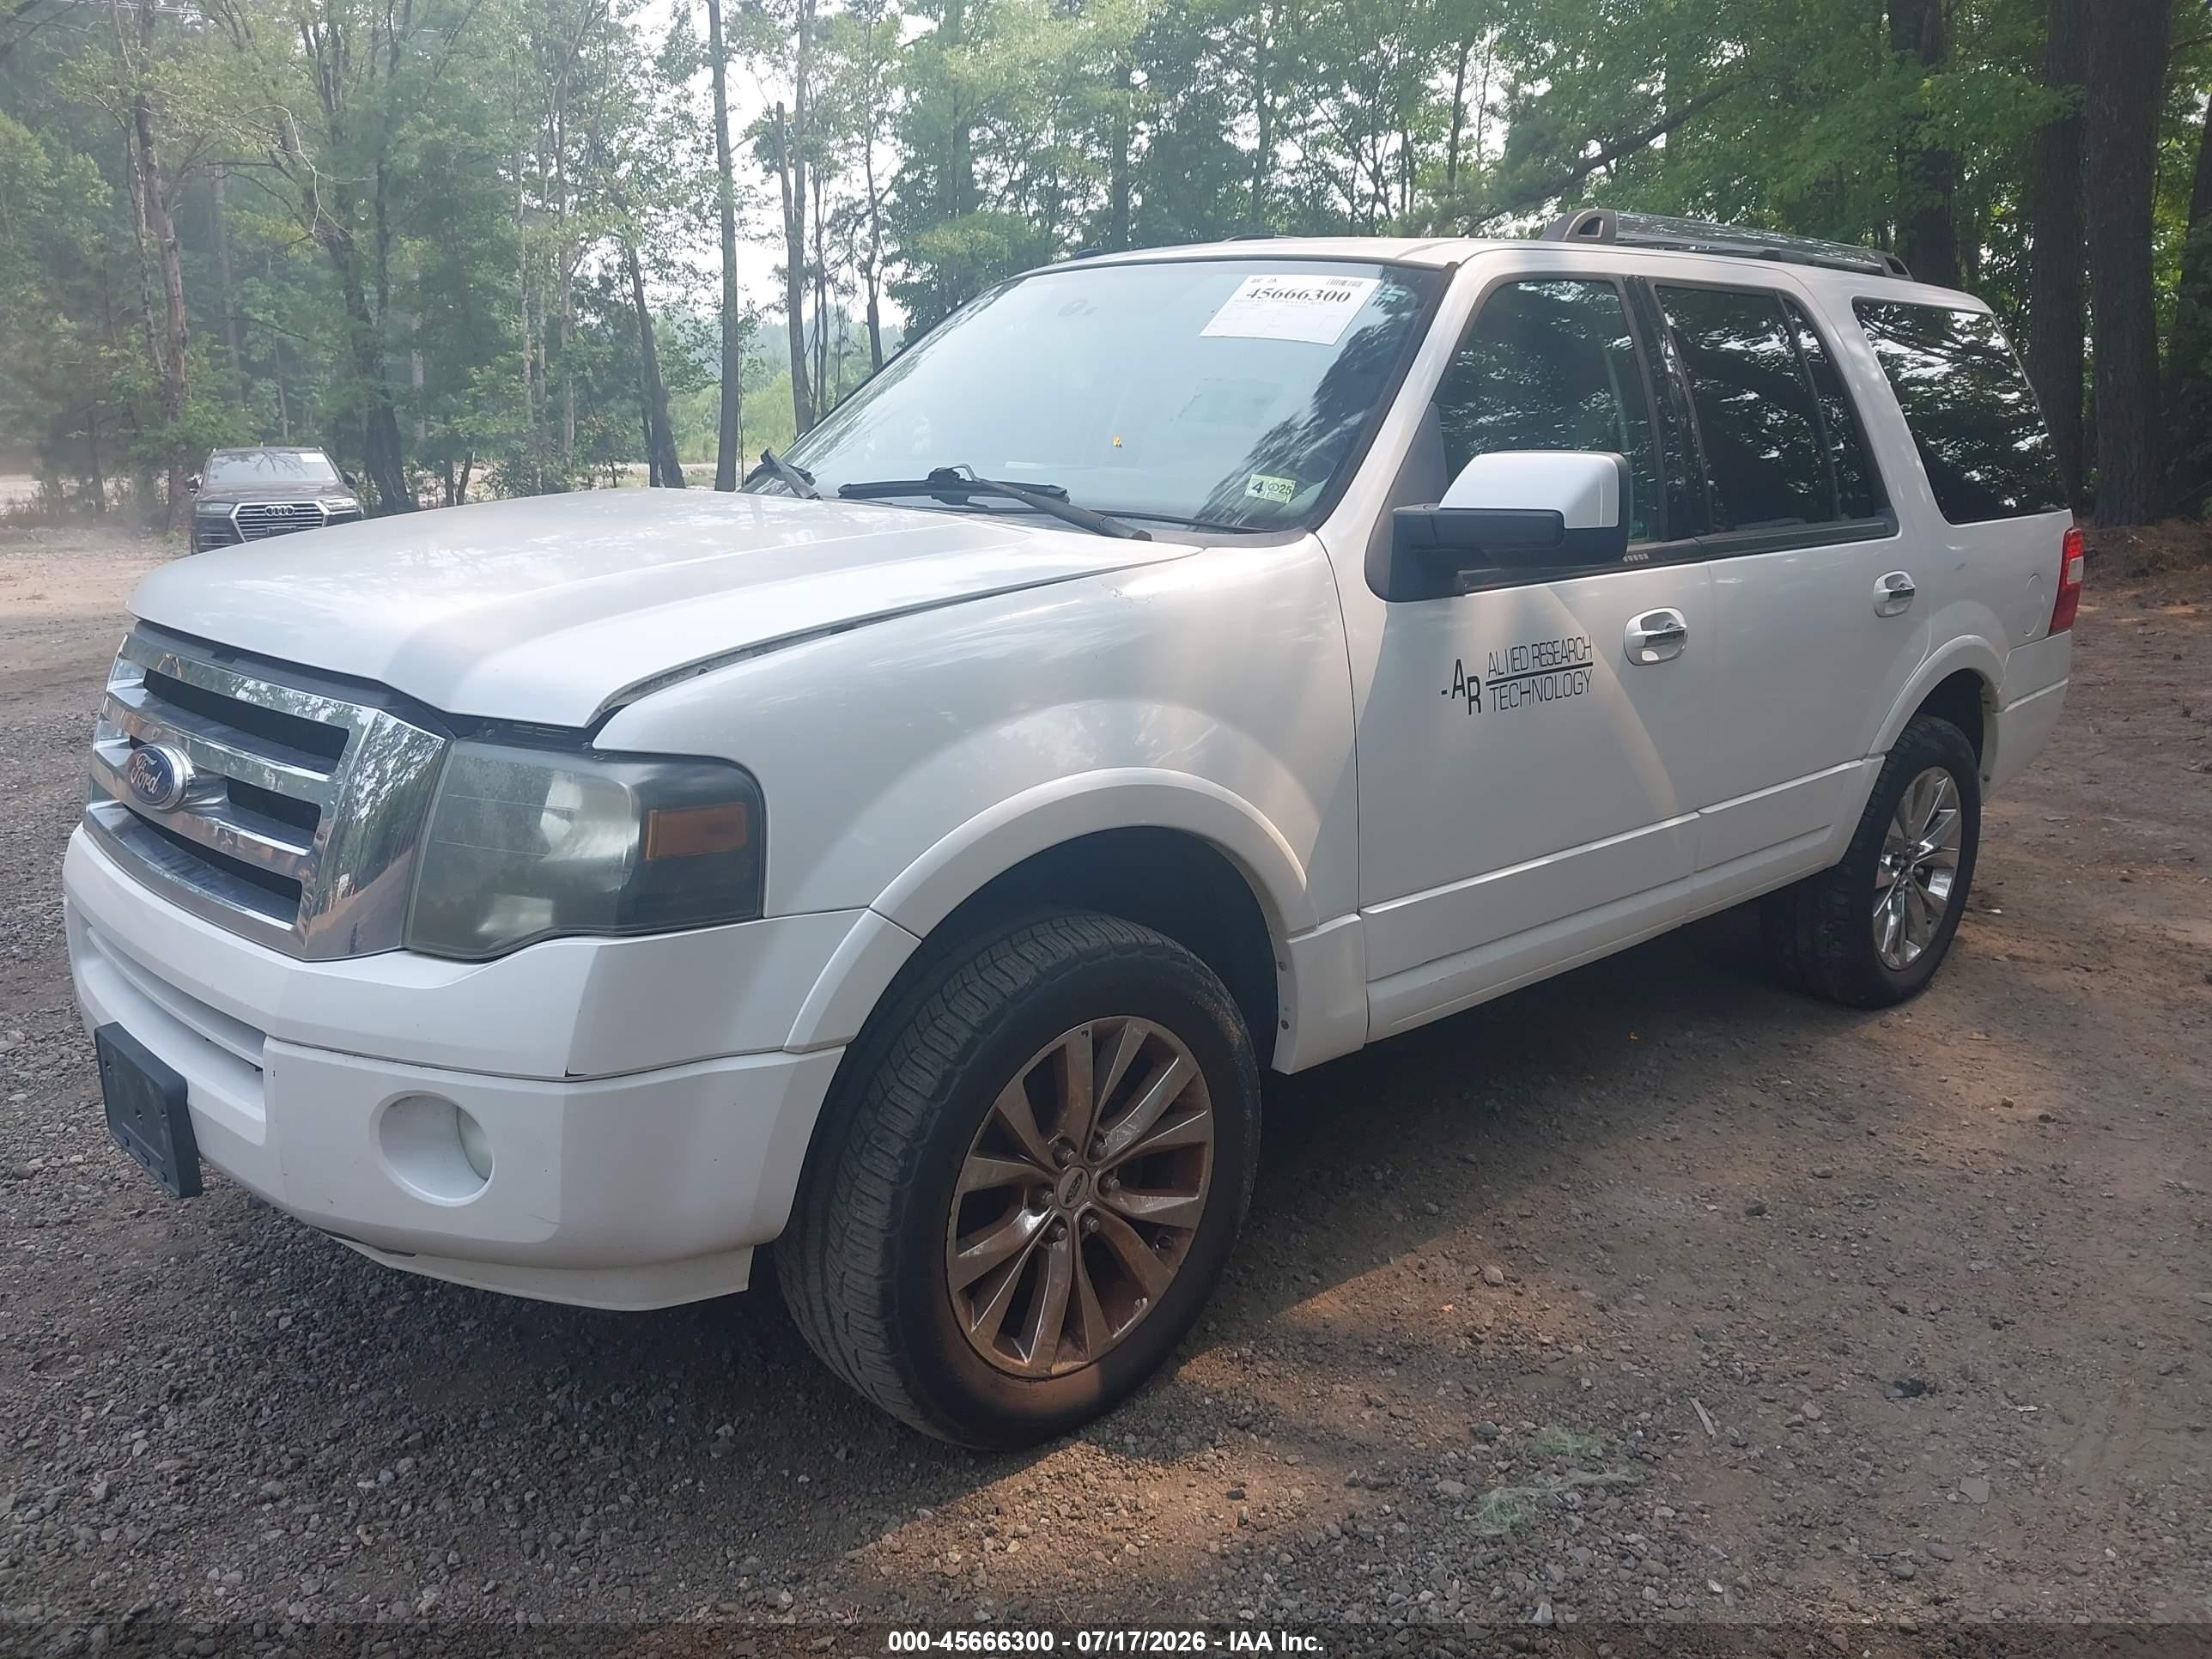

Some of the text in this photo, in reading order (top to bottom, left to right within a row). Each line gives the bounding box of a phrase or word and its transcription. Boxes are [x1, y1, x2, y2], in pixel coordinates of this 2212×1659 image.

[1246, 288, 1351, 303] 45666300
[1252, 481, 1292, 495] 4 25
[1532, 635, 1593, 669] RESEARCH
[1490, 669, 1593, 713] TECHNOLOGY
[131, 753, 163, 795] Ford
